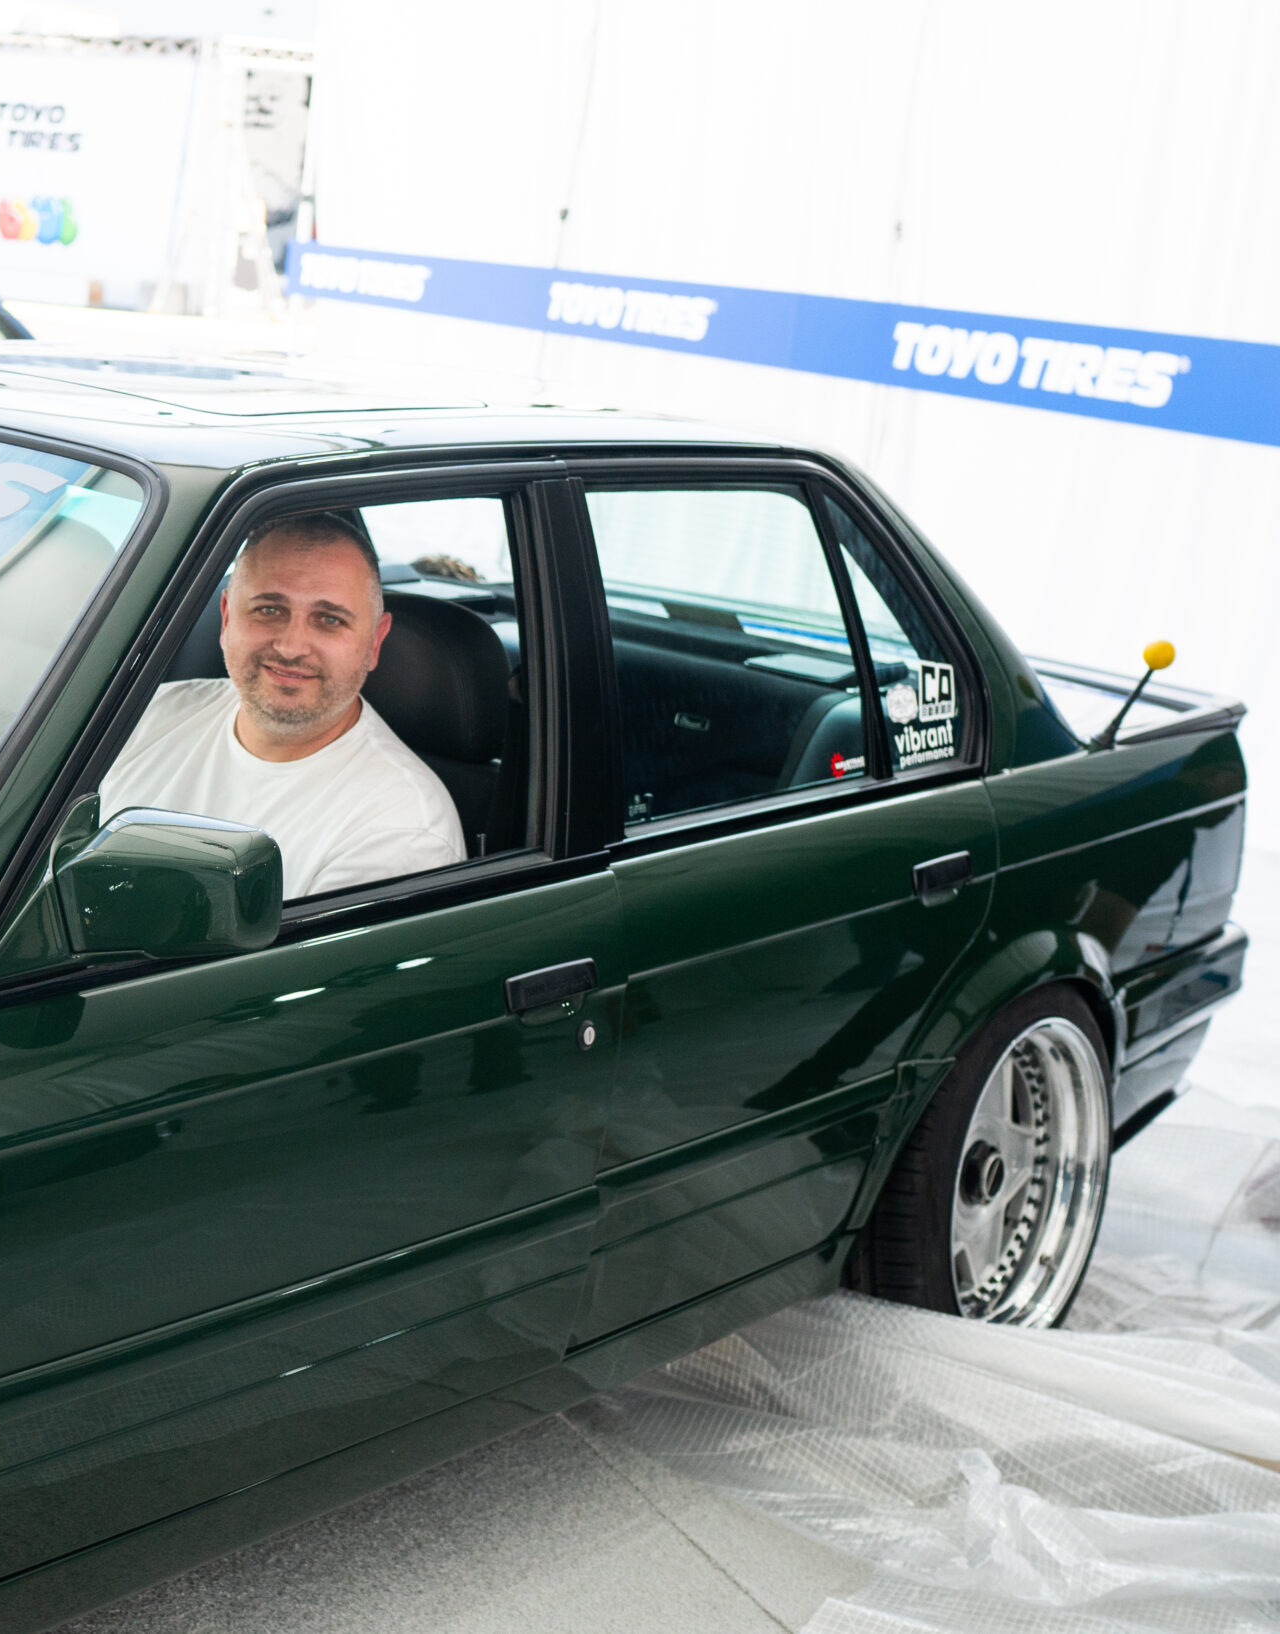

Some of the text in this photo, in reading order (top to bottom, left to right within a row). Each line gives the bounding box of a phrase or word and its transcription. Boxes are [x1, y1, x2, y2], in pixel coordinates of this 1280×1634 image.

[0, 103, 65, 124] TOYO
[9, 129, 81, 152] TIRES
[547, 281, 716, 342] TOYO TIRES
[892, 321, 1182, 408] TOYO TIRES
[894, 719, 953, 754] vibrant
[900, 746, 954, 769] performance
